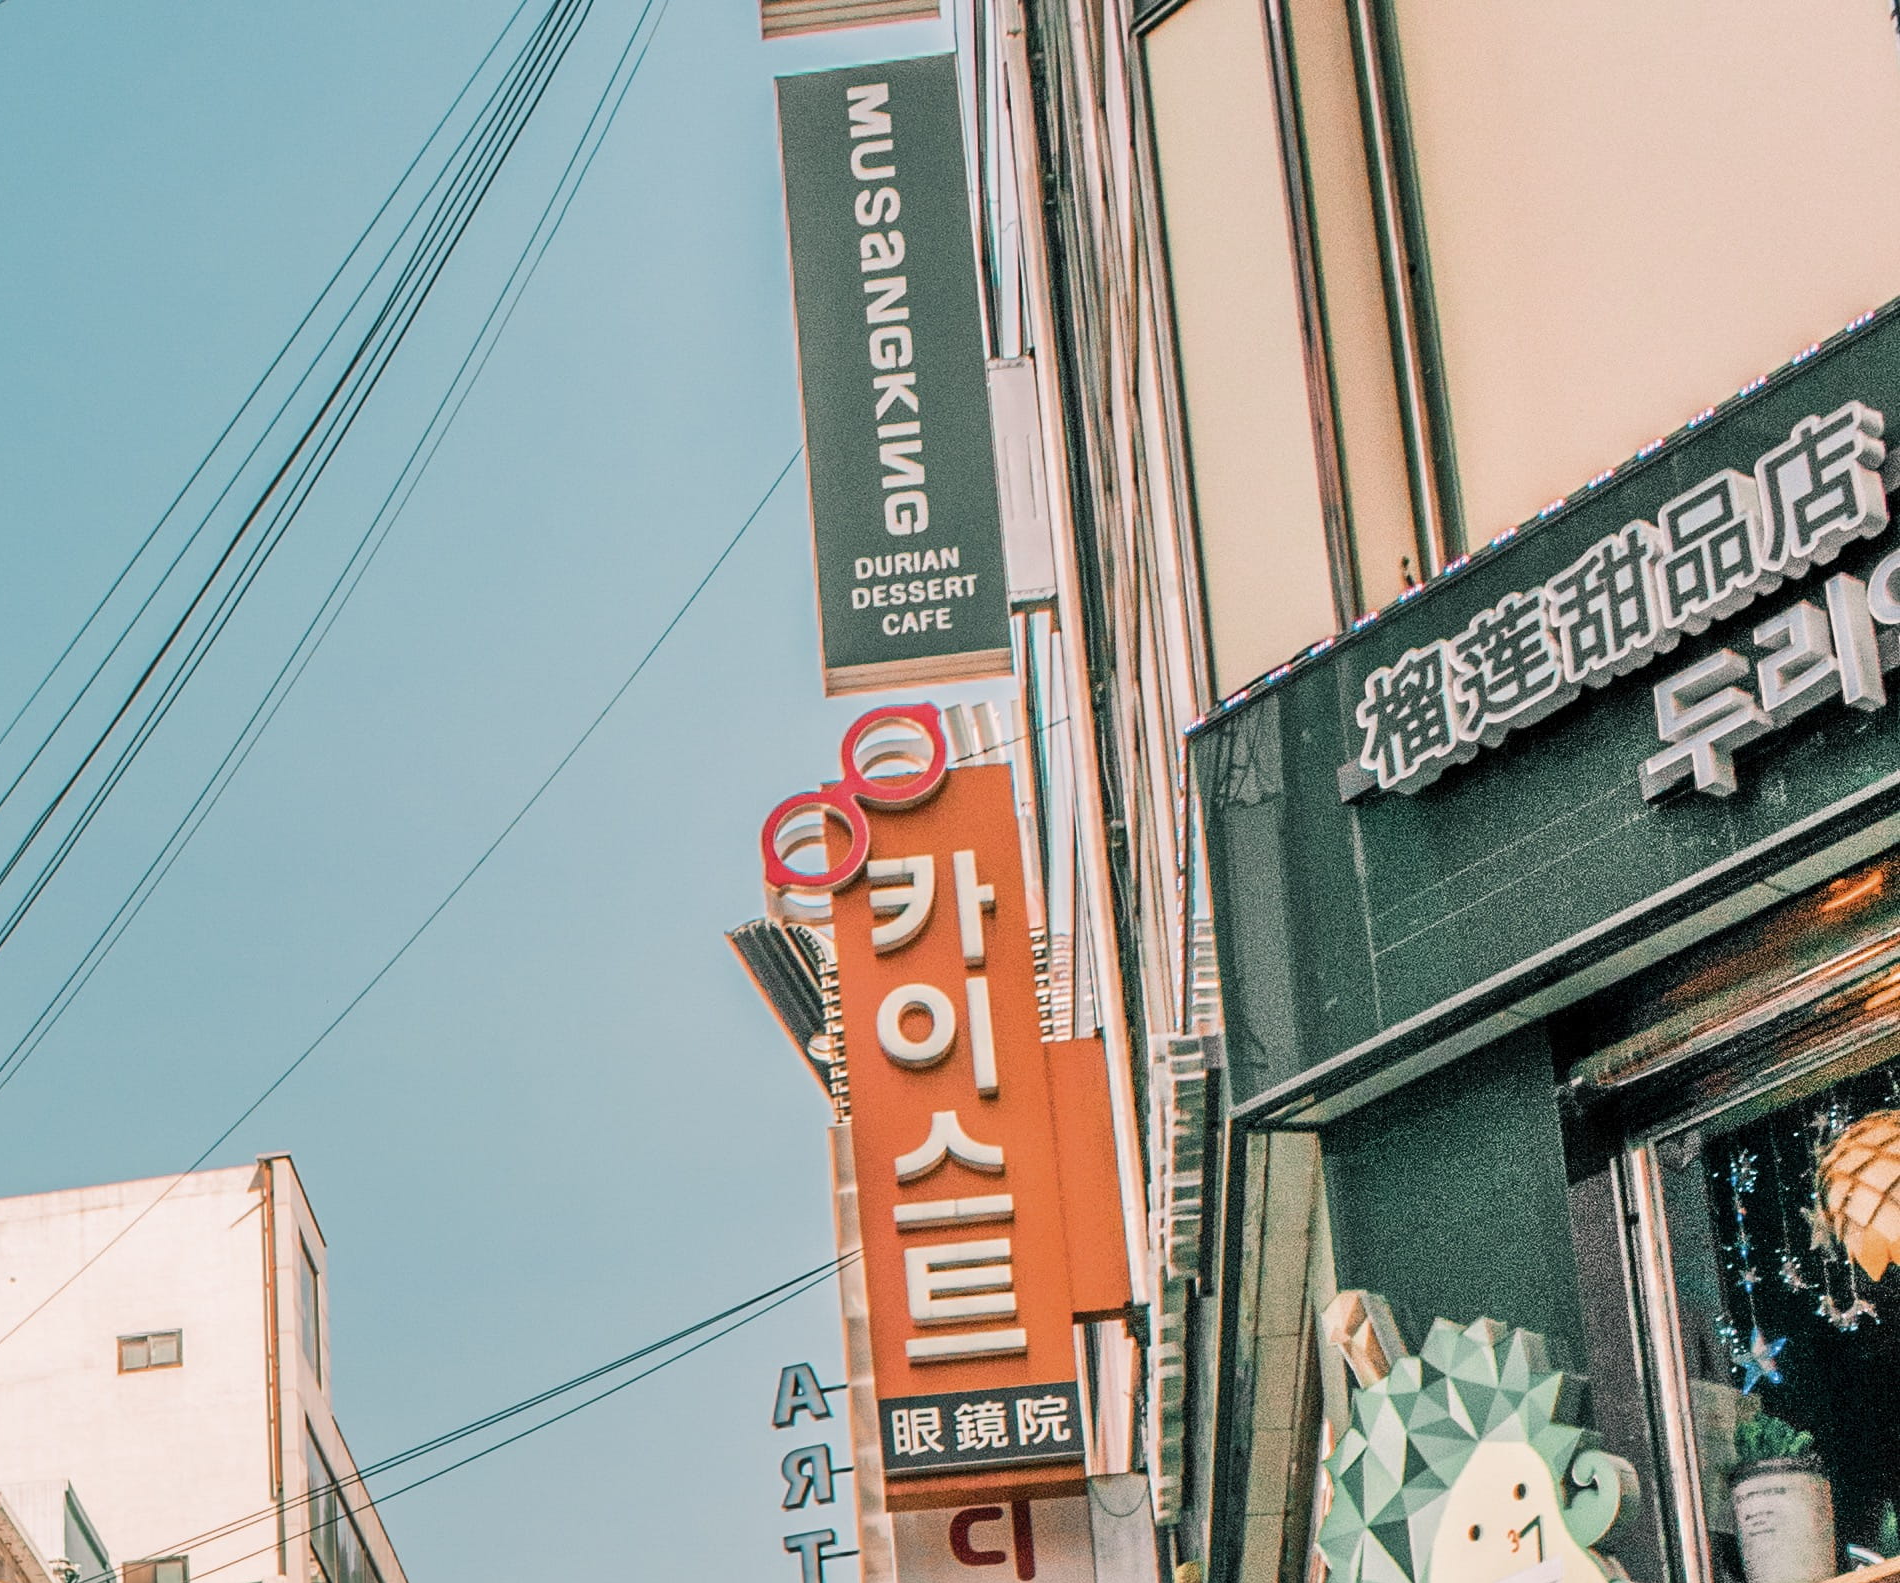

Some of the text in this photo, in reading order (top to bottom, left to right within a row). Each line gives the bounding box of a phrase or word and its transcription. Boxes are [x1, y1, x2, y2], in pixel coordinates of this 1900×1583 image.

[855, 547, 959, 582] DURIAN
[851, 574, 977, 611] DESSERT
[881, 607, 952, 636] CAFE
[867, 850, 1027, 1362] 카이스트
[890, 1395, 1072, 1457] 眼鏡院
